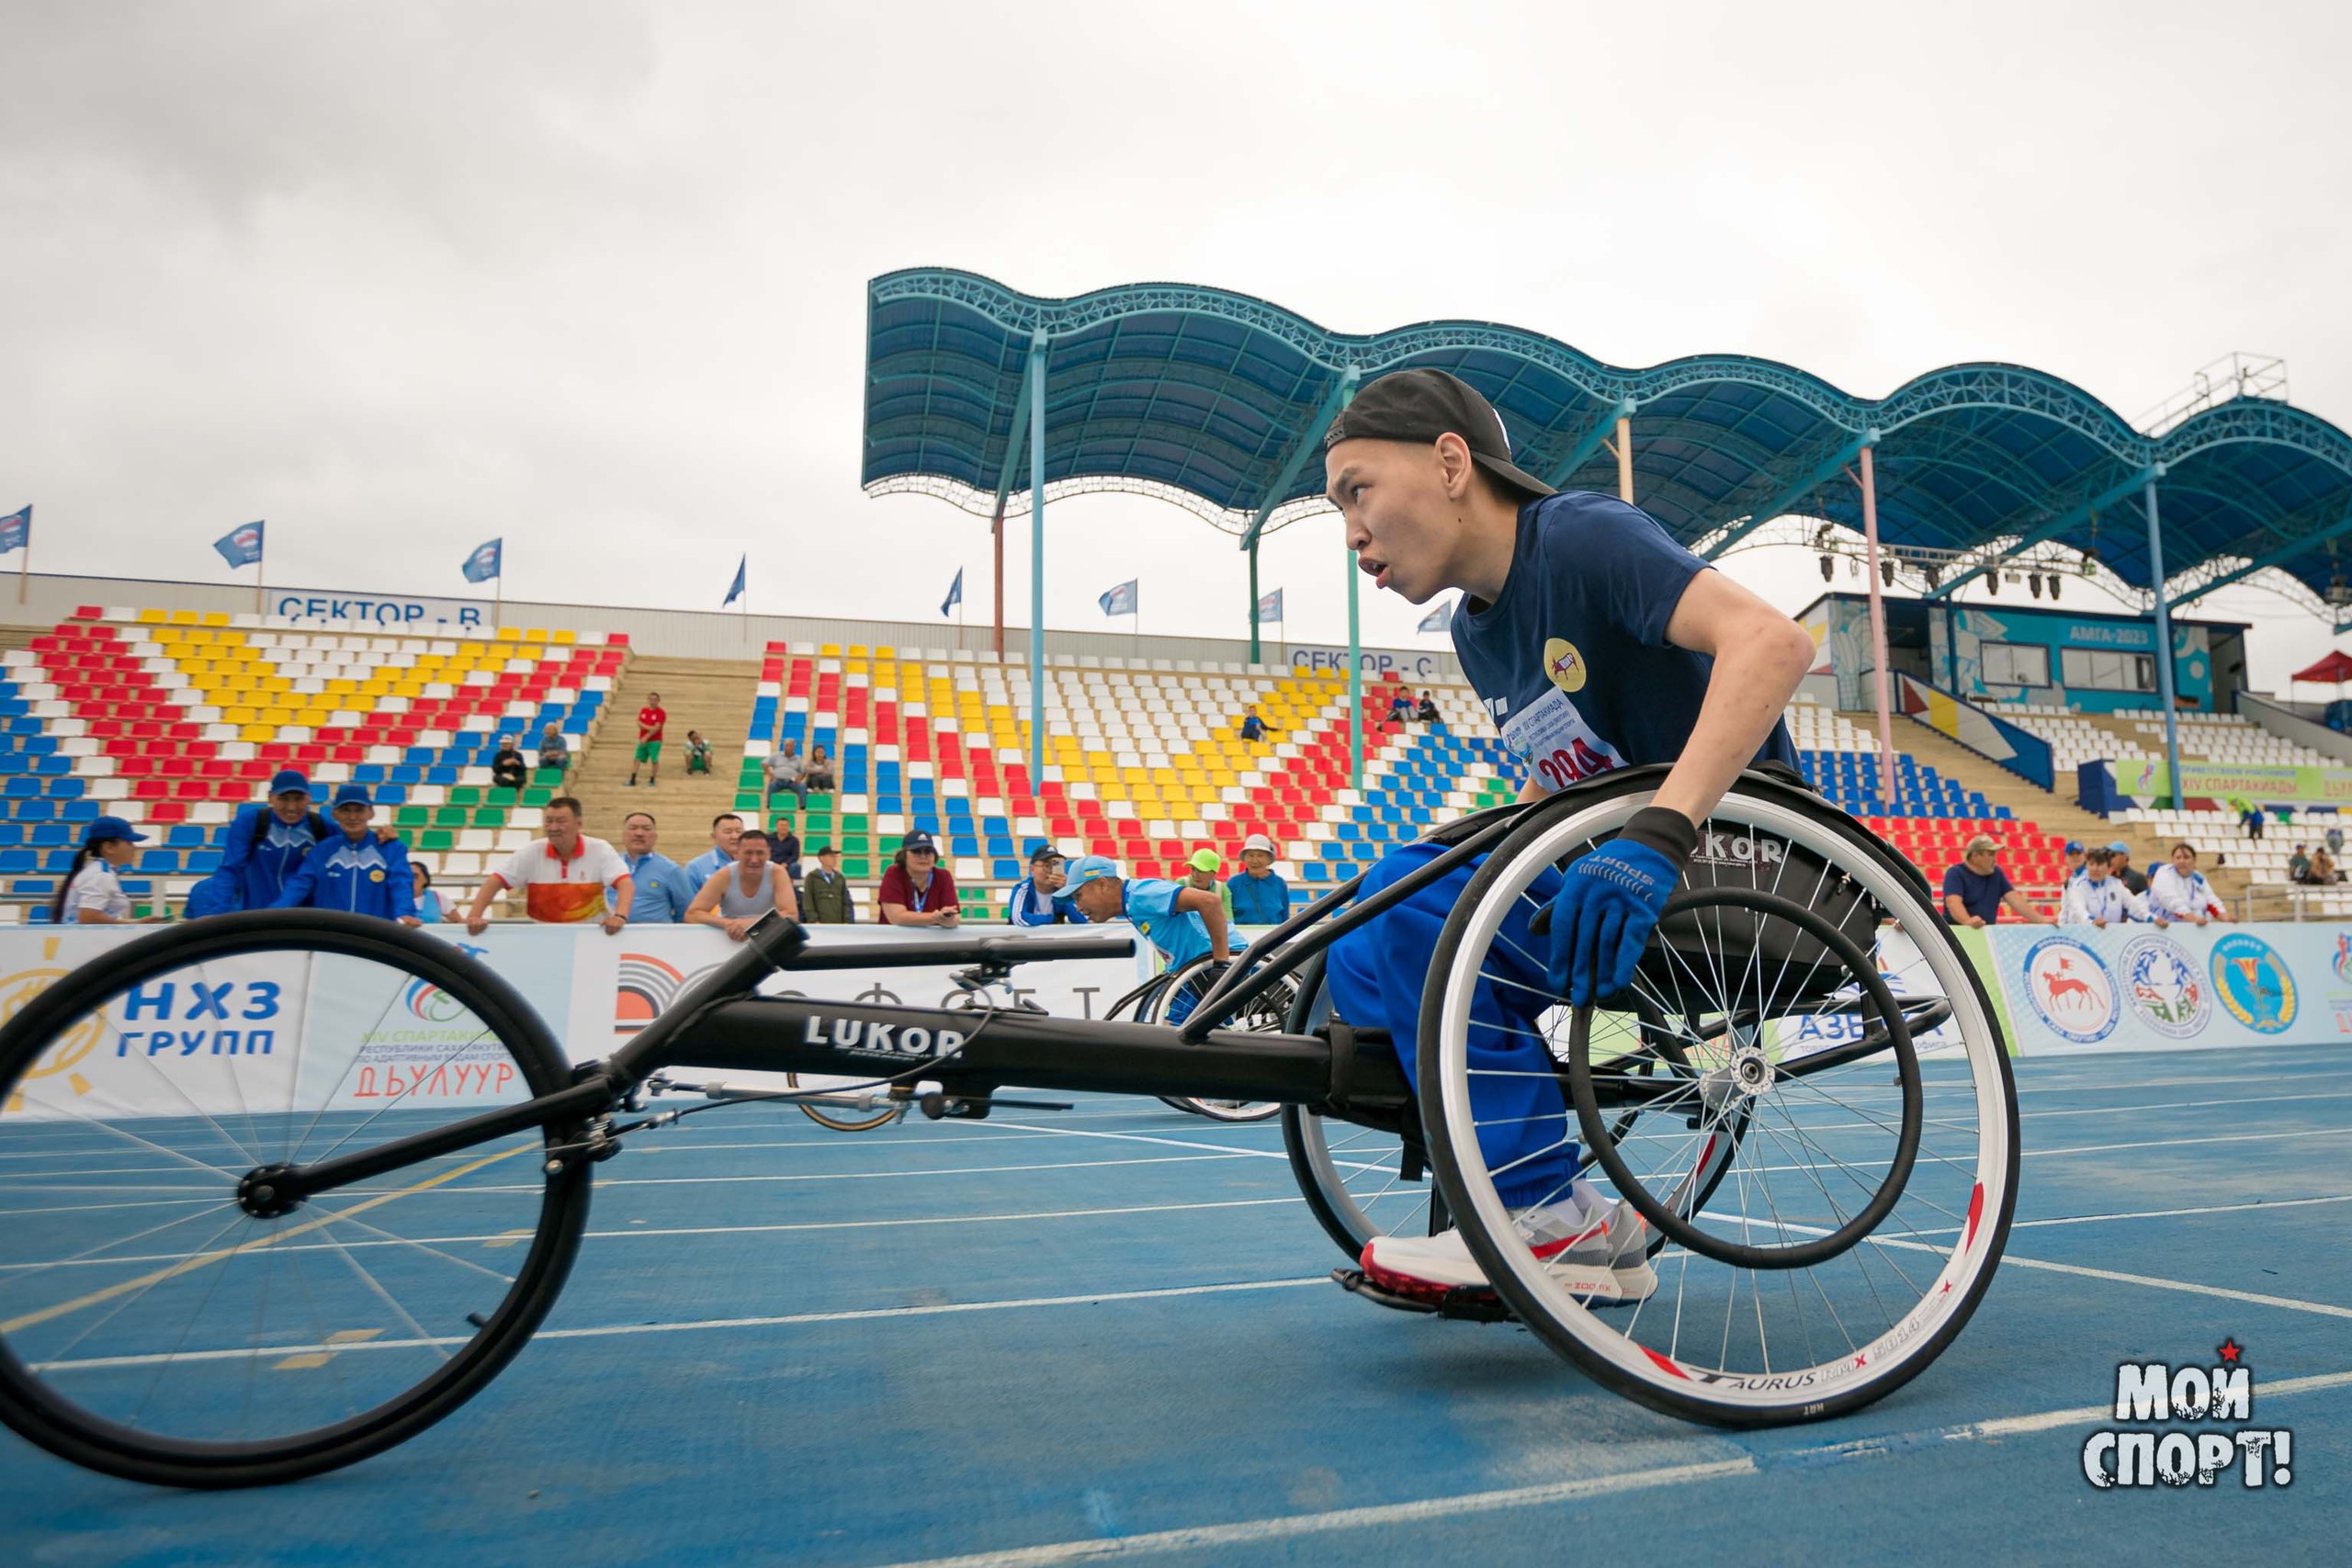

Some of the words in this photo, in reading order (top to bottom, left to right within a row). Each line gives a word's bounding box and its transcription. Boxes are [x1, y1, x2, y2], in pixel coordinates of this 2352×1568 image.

[1293, 650, 1393, 675] СЕКОР
[1690, 832, 1782, 863] KOR
[1588, 855, 1656, 886] SPORT
[116, 1030, 275, 1057] ГРУПП
[805, 1014, 966, 1059] LUKOR
[1690, 1367, 1817, 1392] TAURUS
